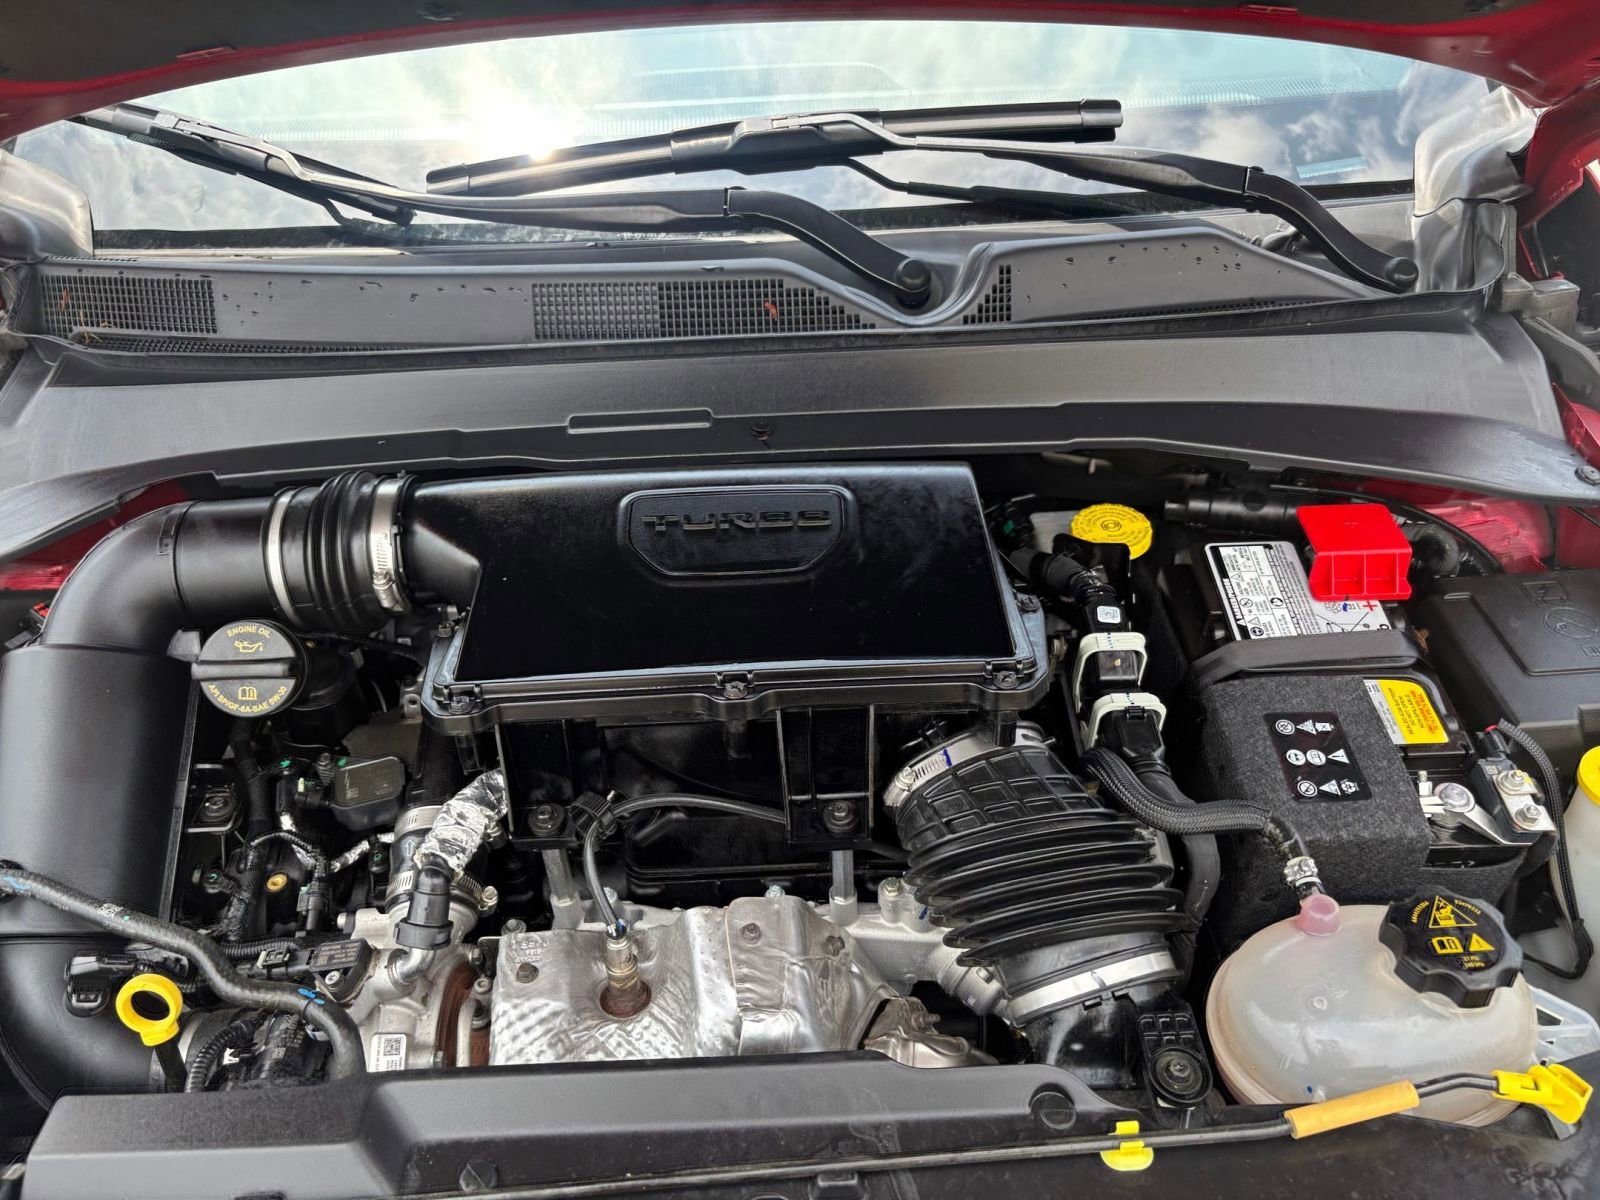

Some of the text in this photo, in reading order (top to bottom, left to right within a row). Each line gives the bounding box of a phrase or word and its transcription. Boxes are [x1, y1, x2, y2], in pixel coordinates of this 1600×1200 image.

[641, 510, 833, 532] TURBO
[227, 625, 271, 639] ENGINE OIL
[208, 684, 221, 698] API
[268, 685, 288, 703] 5W-30
